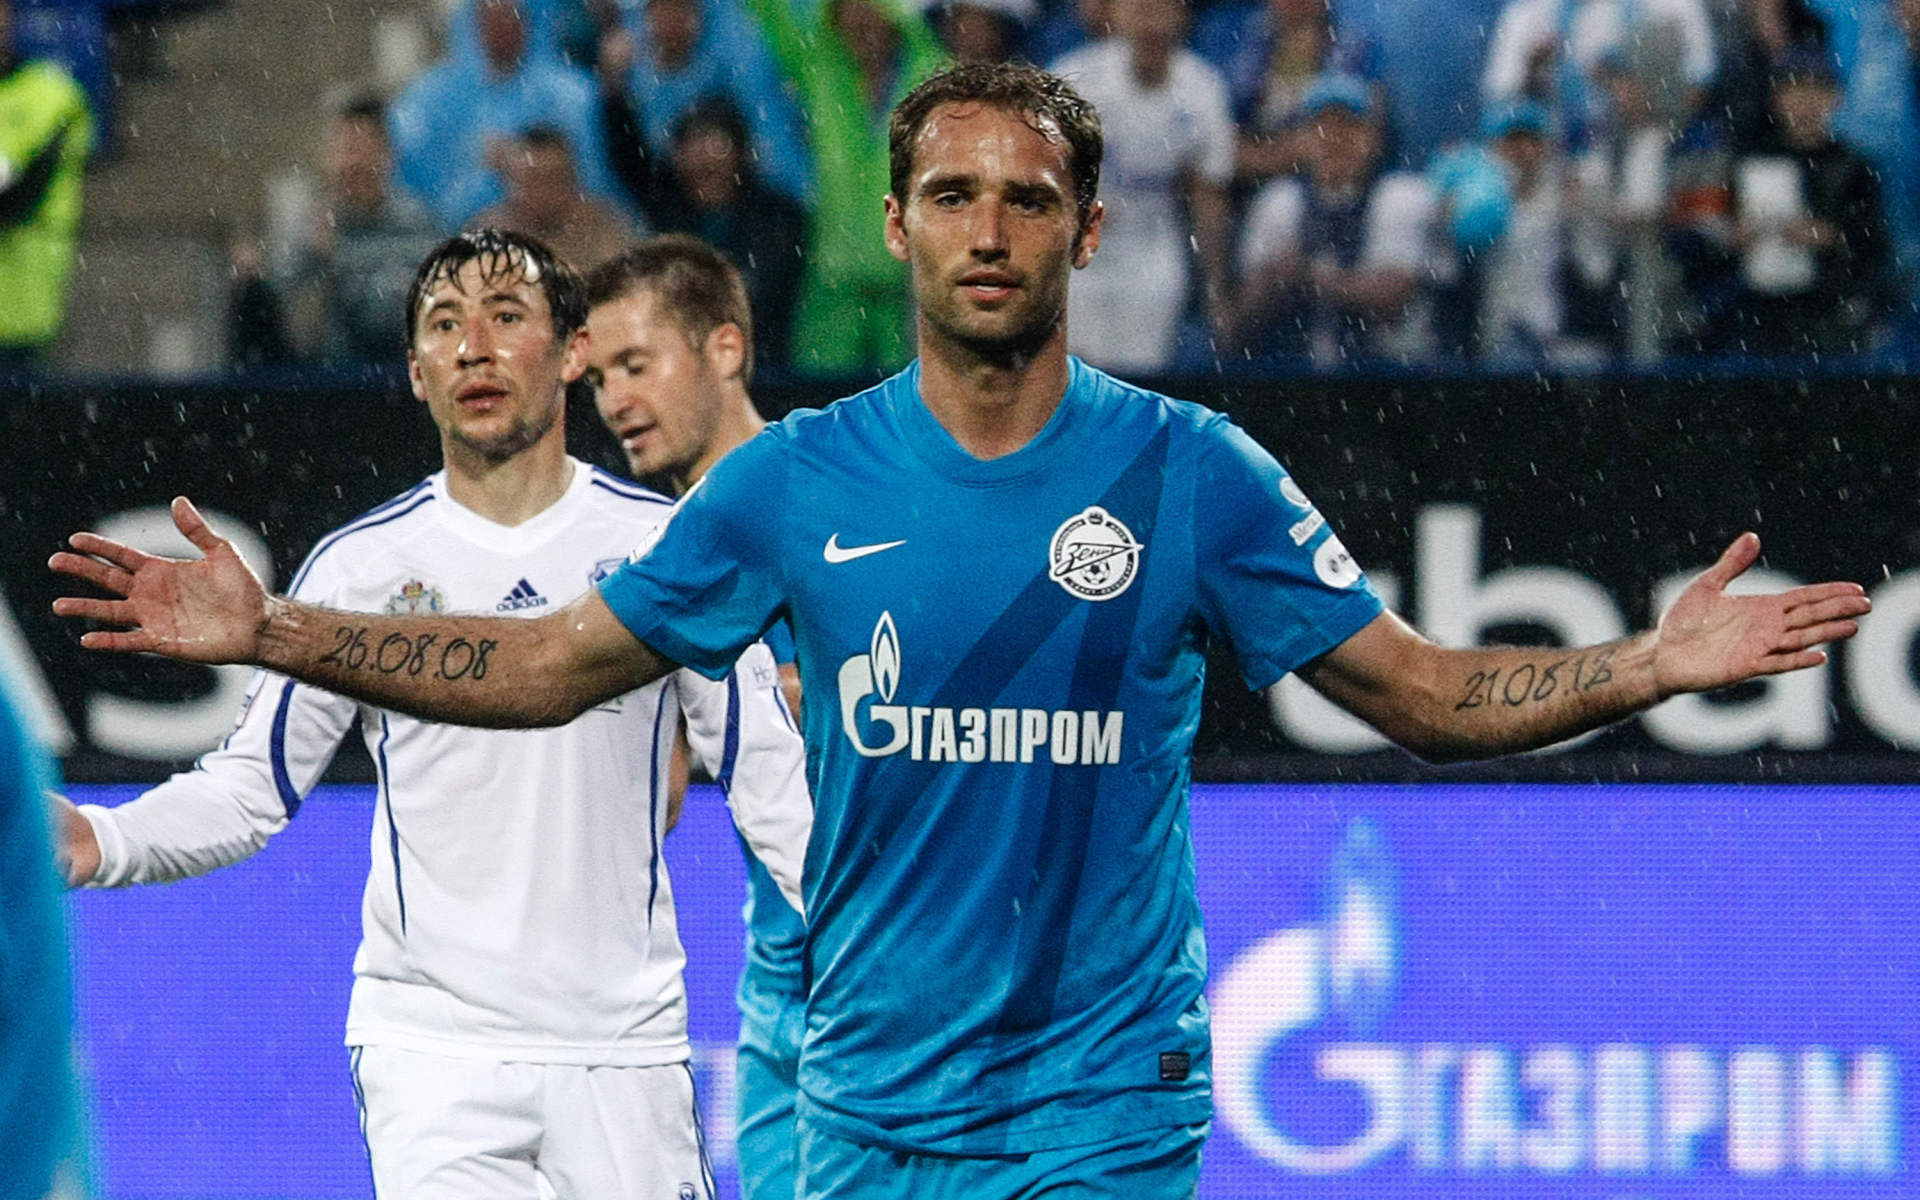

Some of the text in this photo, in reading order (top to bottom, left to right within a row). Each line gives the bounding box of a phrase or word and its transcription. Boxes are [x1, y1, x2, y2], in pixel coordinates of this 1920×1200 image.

[496, 596, 548, 612] adidas
[317, 625, 499, 681] 26.08.08
[910, 706, 1124, 765] ГАЗПРОМ
[1408, 1041, 1897, 1174] ГАЗПРОМ
